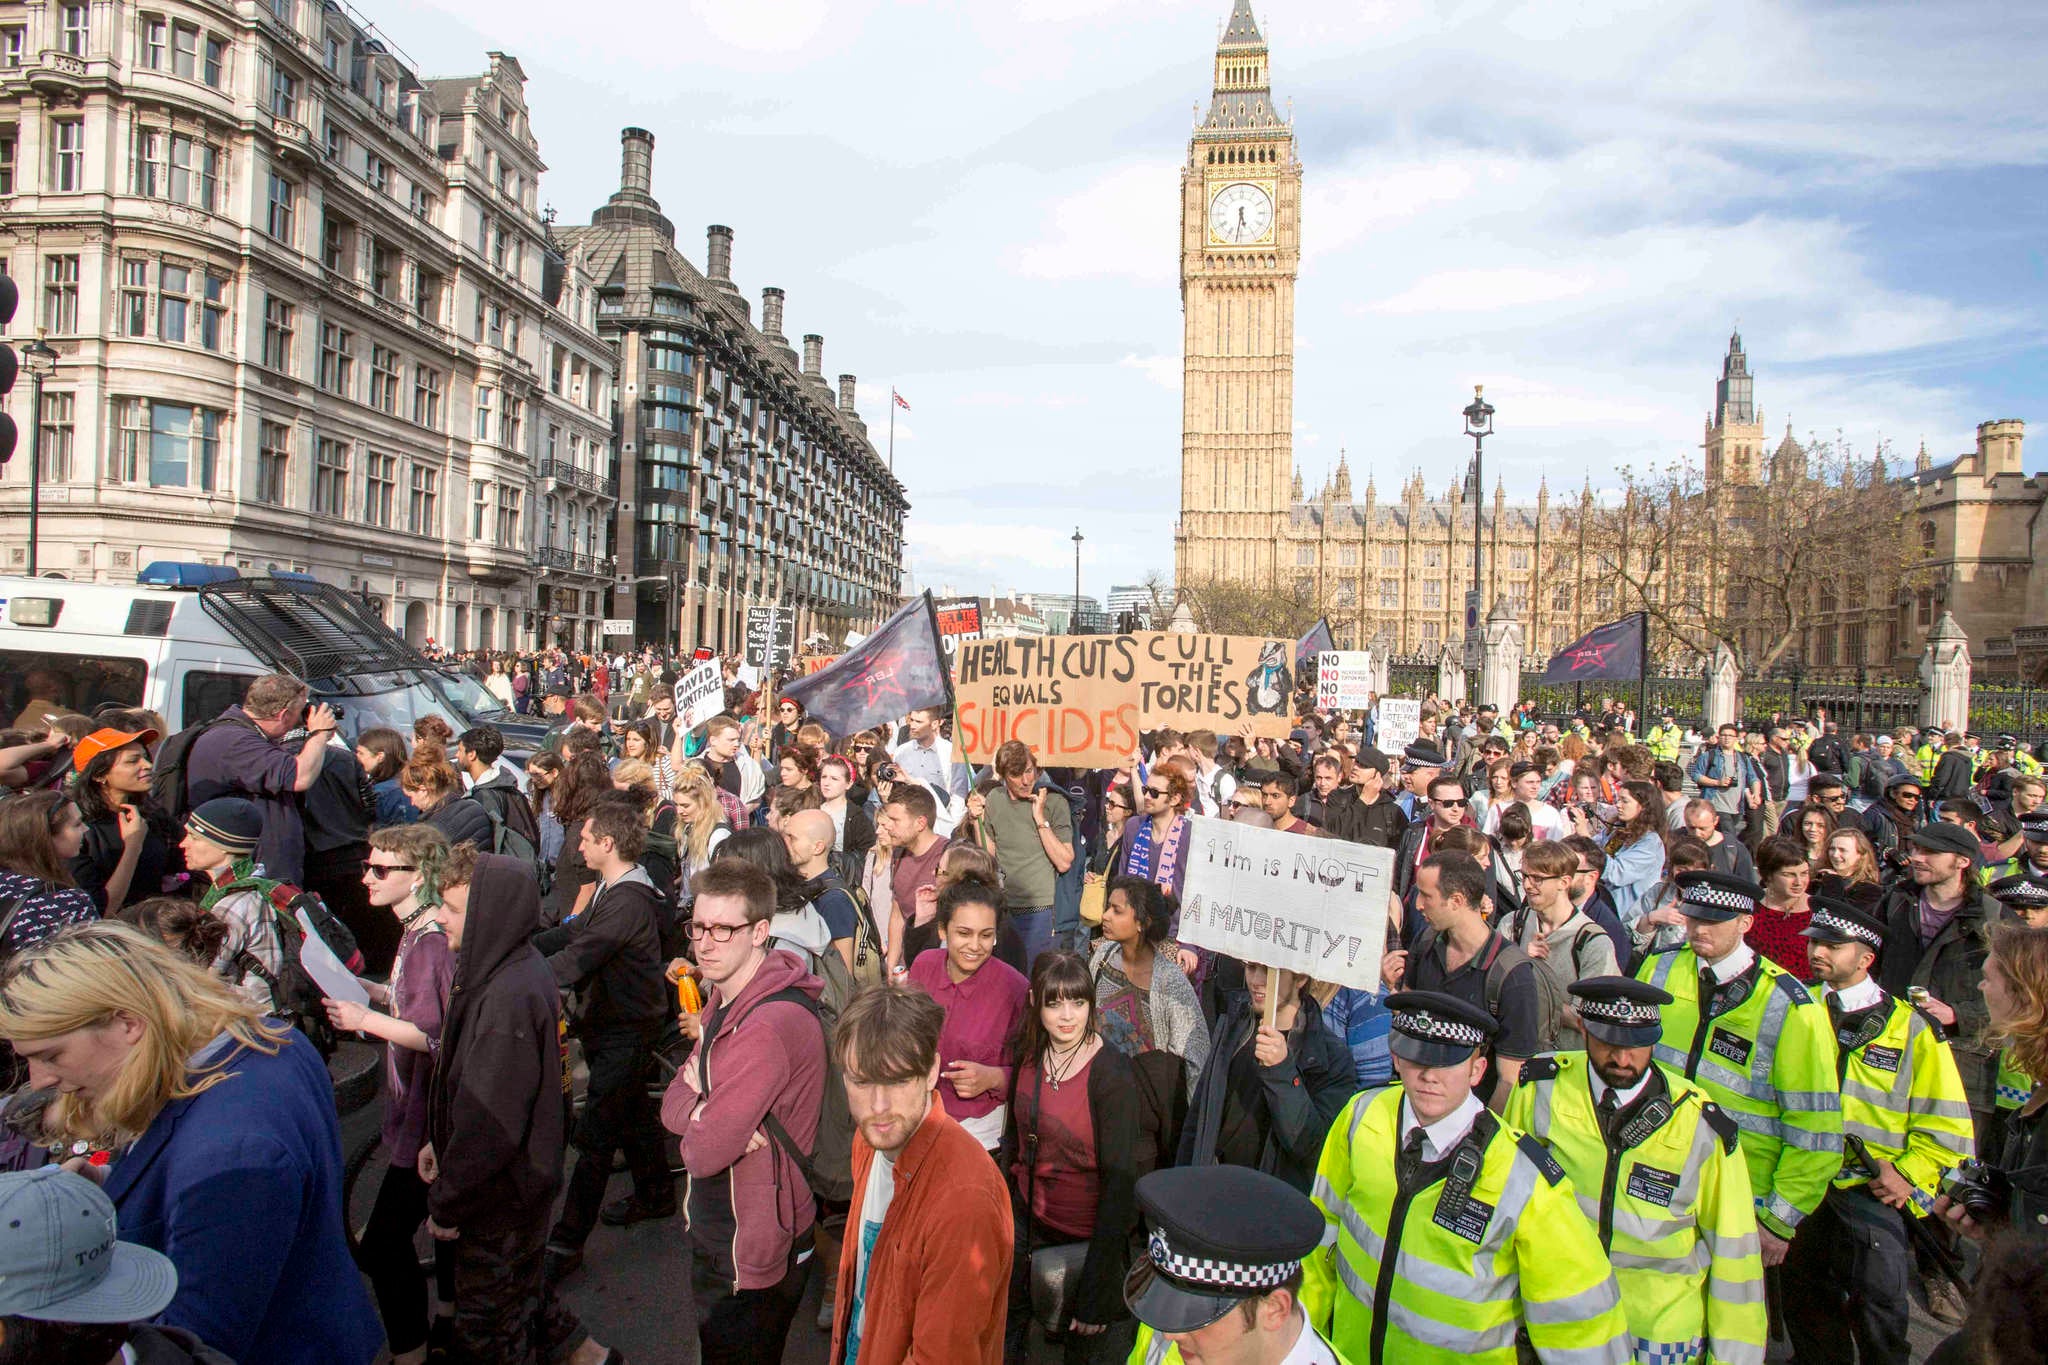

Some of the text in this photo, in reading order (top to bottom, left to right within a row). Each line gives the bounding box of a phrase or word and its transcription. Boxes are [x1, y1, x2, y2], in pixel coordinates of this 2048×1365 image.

[936, 608, 979, 622] GET THE
[938, 619, 980, 636] TORIES
[960, 638, 1055, 685] HEALTH
[1062, 636, 1138, 683] CUTS
[1148, 634, 1233, 665] CULL
[1321, 654, 1340, 667] NO
[676, 667, 714, 698] DAVID
[1168, 662, 1223, 689] THE
[1320, 682, 1338, 695] NO
[1321, 669, 1339, 681] NO
[677, 676, 721, 712] CUNTFACE
[993, 680, 1063, 707] EQUALS
[1141, 680, 1242, 720] TORIES
[1319, 695, 1337, 708] NO
[958, 701, 1139, 757] SUICIDES
[1264, 858, 1281, 876] is
[1292, 853, 1379, 893] NOT
[1183, 893, 1362, 967] A MAJORITY!
[1712, 1043, 1745, 1064] POLICE
[1628, 1188, 1669, 1206] POLICE OFFICER
[1434, 1215, 1456, 1231] POLICE
[1455, 1226, 1481, 1243] OFFICER
